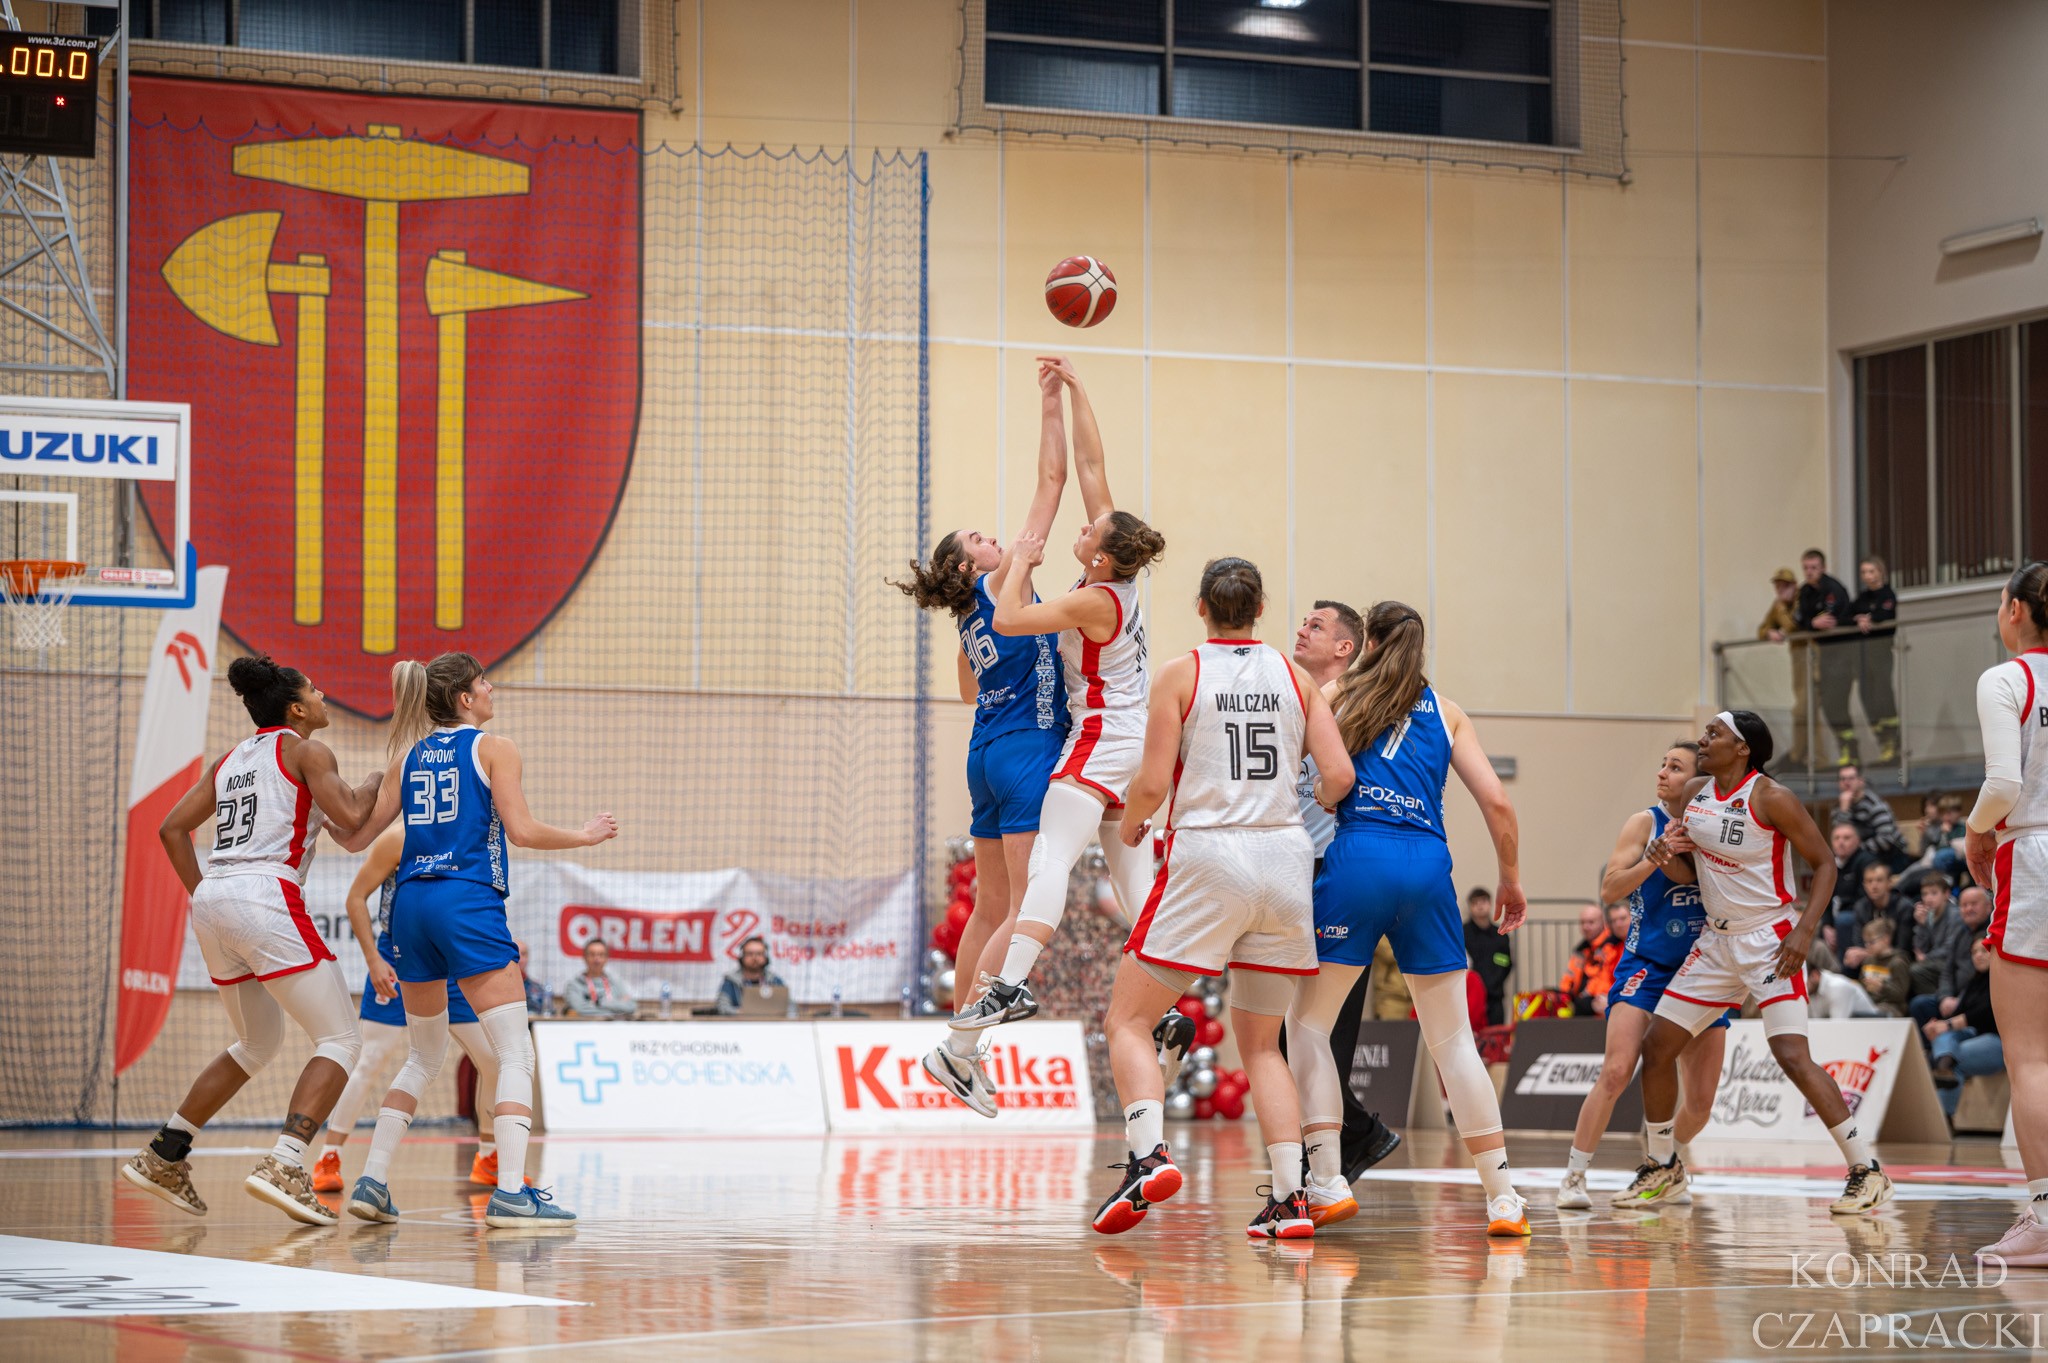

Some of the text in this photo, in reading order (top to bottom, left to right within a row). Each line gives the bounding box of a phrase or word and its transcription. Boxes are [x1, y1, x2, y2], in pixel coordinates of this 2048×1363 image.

[27, 35, 98, 50] www.3d.com.pl
[0, 429, 159, 466] UZUKI
[1215, 693, 1280, 713] WALCZAK
[1410, 699, 1435, 714] SKA
[1224, 721, 1279, 781] 15
[407, 766, 460, 826] 33
[212, 792, 258, 851] 23
[1720, 819, 1745, 846] 16
[567, 913, 705, 953] ORLEN
[122, 967, 171, 996] ORLEN
[629, 1039, 743, 1056] PRZYCHODNIA
[836, 1044, 1074, 1111] Krika
